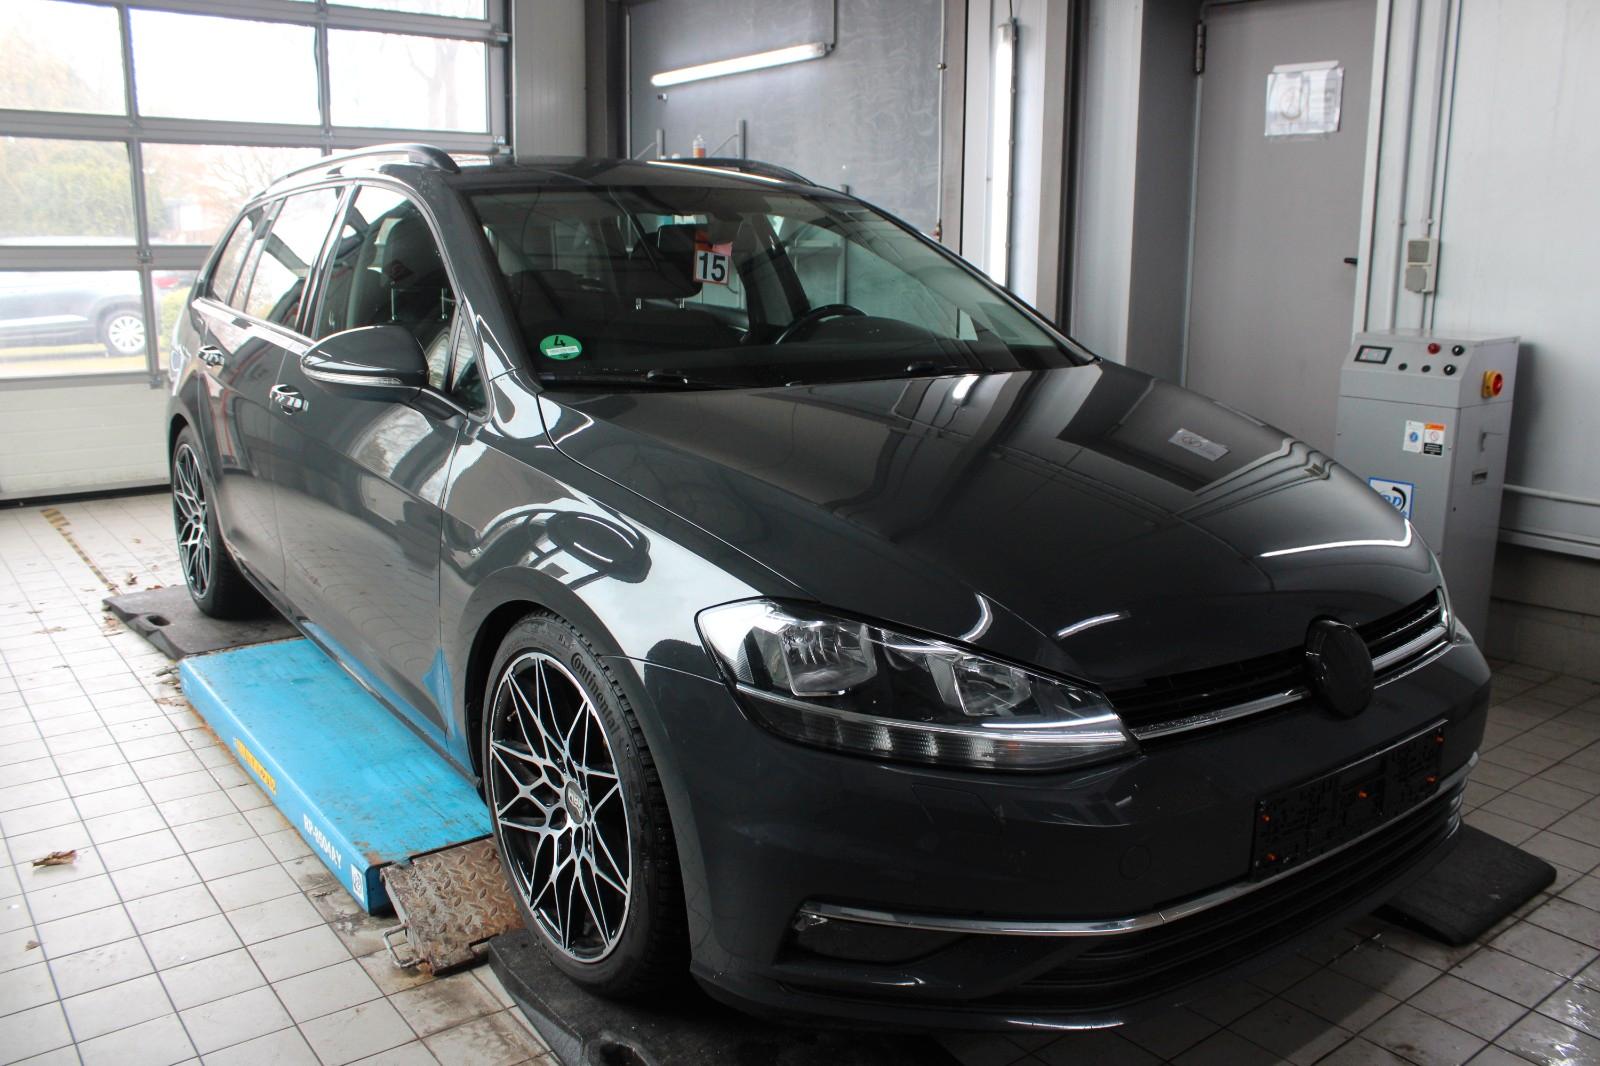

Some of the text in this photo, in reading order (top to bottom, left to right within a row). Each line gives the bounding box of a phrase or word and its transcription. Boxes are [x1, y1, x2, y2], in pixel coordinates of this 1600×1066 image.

[699, 252, 726, 281] 15
[554, 335, 566, 347] 4
[571, 652, 620, 735] Continental
